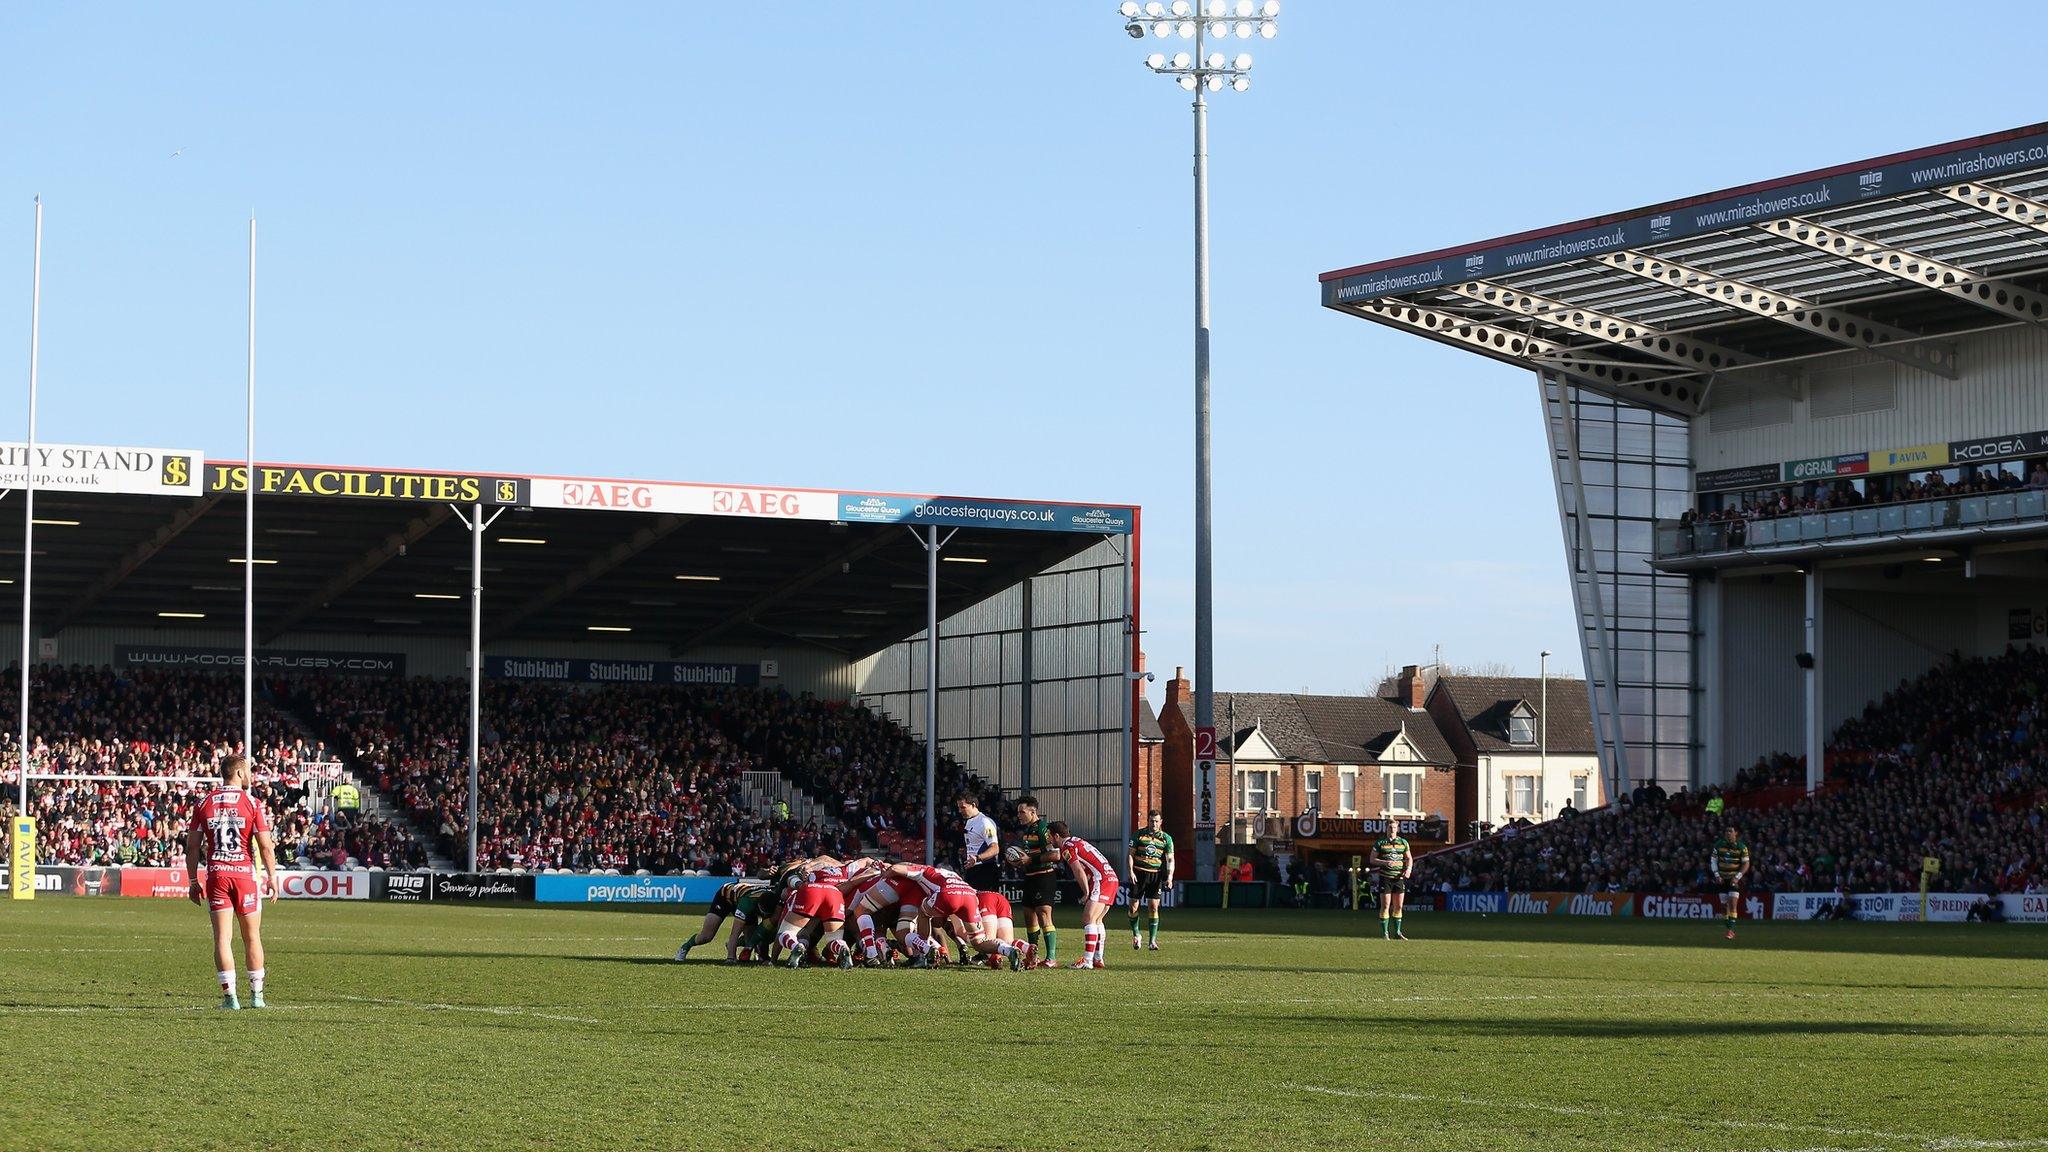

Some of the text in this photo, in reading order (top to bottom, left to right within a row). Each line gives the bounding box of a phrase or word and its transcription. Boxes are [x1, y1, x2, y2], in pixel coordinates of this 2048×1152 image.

[1860, 171, 1882, 186] mira
[1696, 184, 1831, 227] www.mirashowers.co.uk
[1650, 215, 1671, 229] mira
[1505, 227, 1625, 267] www.mirashowers.co.uk
[1465, 254, 1484, 267] mira
[1337, 265, 1443, 299] www.mirashowers.co.uk
[62, 449, 154, 473] STAND
[1900, 451, 1928, 463] AVIVA
[1804, 459, 1835, 477] GRAIL
[212, 467, 248, 491] JS
[260, 468, 481, 502] FACILITIES
[585, 484, 652, 509] AEG
[734, 493, 800, 516] AEG
[914, 502, 1055, 523] gloucesterquays.co.uk
[504, 660, 570, 679] StubHub!
[589, 663, 654, 682] StubHub!
[673, 665, 737, 684] StubHub!
[1198, 732, 1213, 755] 2
[215, 827, 238, 852] 13
[19, 840, 30, 892] AVIVA
[388, 874, 424, 888] mira
[586, 881, 687, 902] payrollsimply
[1464, 894, 1499, 912] USN
[1643, 895, 1714, 918] Citizen
[1865, 896, 1894, 913] STORY
